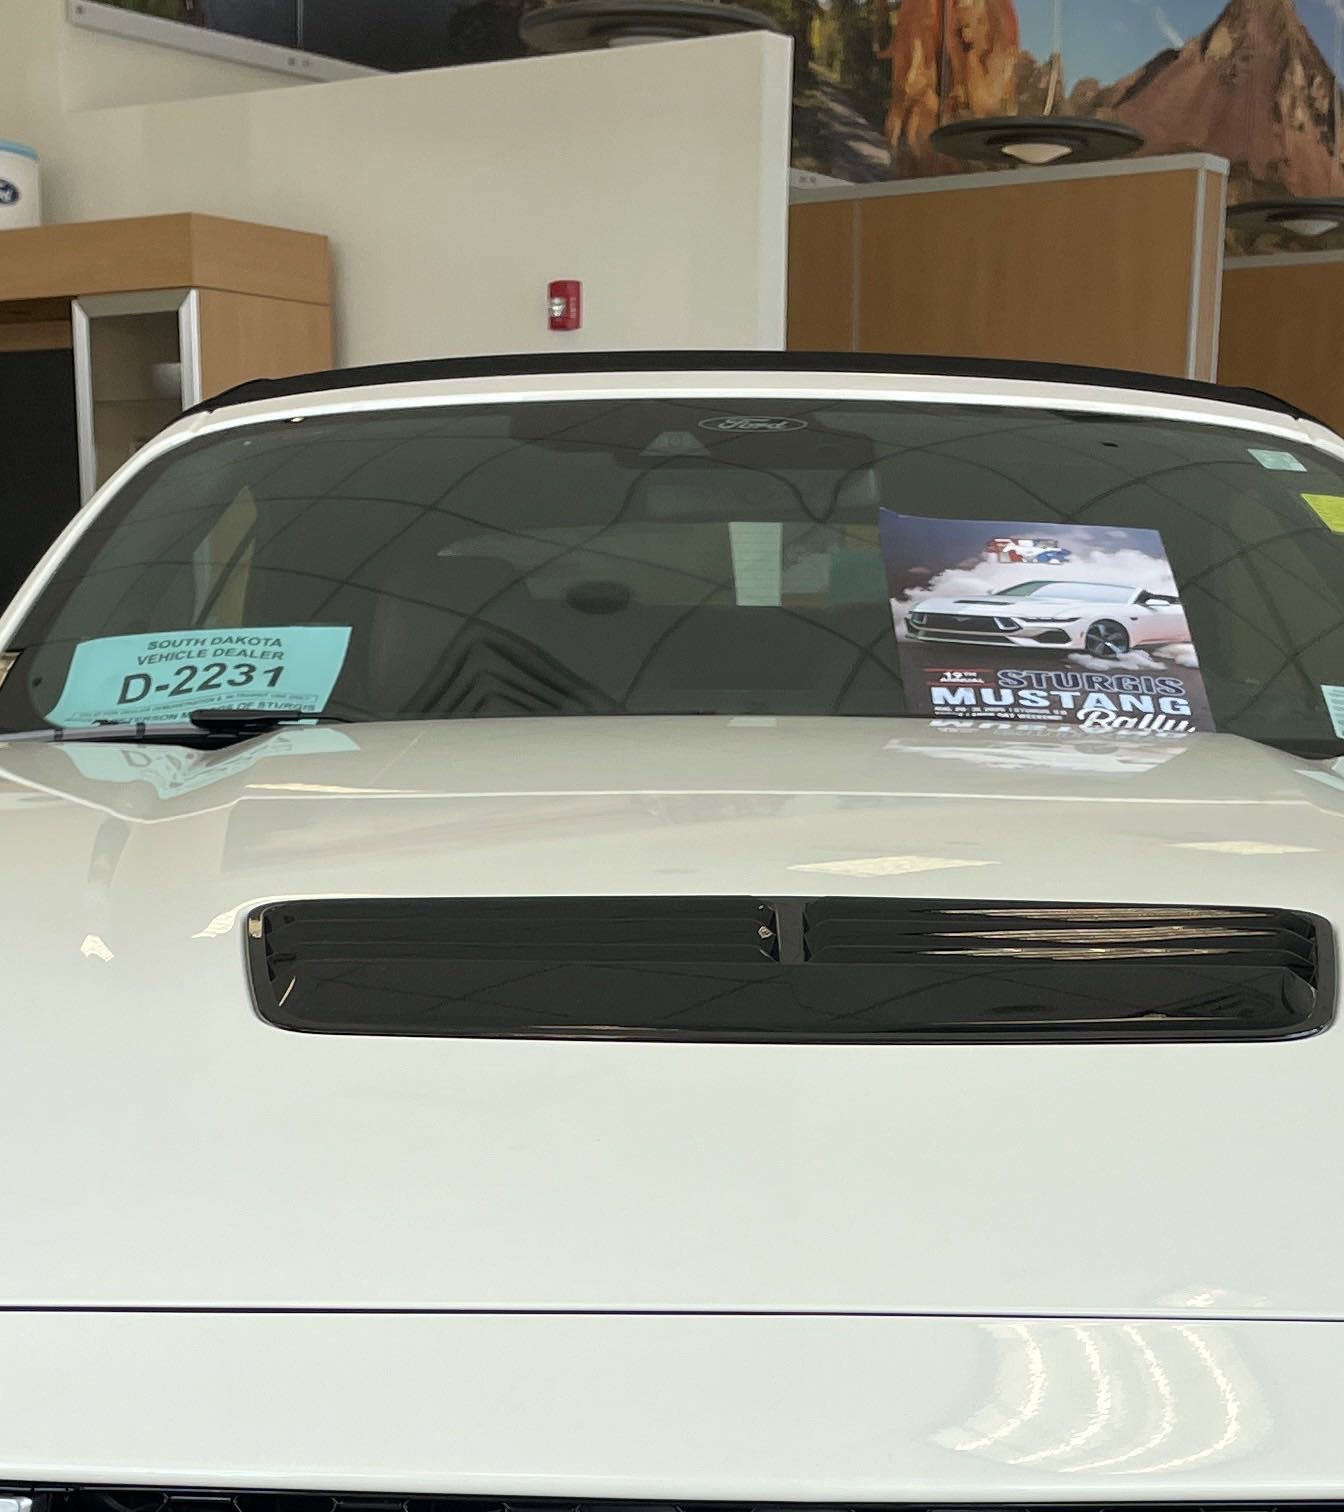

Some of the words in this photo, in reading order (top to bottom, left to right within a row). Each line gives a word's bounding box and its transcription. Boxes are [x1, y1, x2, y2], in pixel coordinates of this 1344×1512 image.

[137, 649, 207, 665] VEHICLE
[212, 648, 285, 660] DEALER
[147, 638, 206, 650] SOUTH
[210, 636, 283, 648] DAKOTA
[116, 662, 285, 705] D-2231
[997, 669, 1186, 696] STURGIS
[930, 686, 1192, 716] MUSTANG
